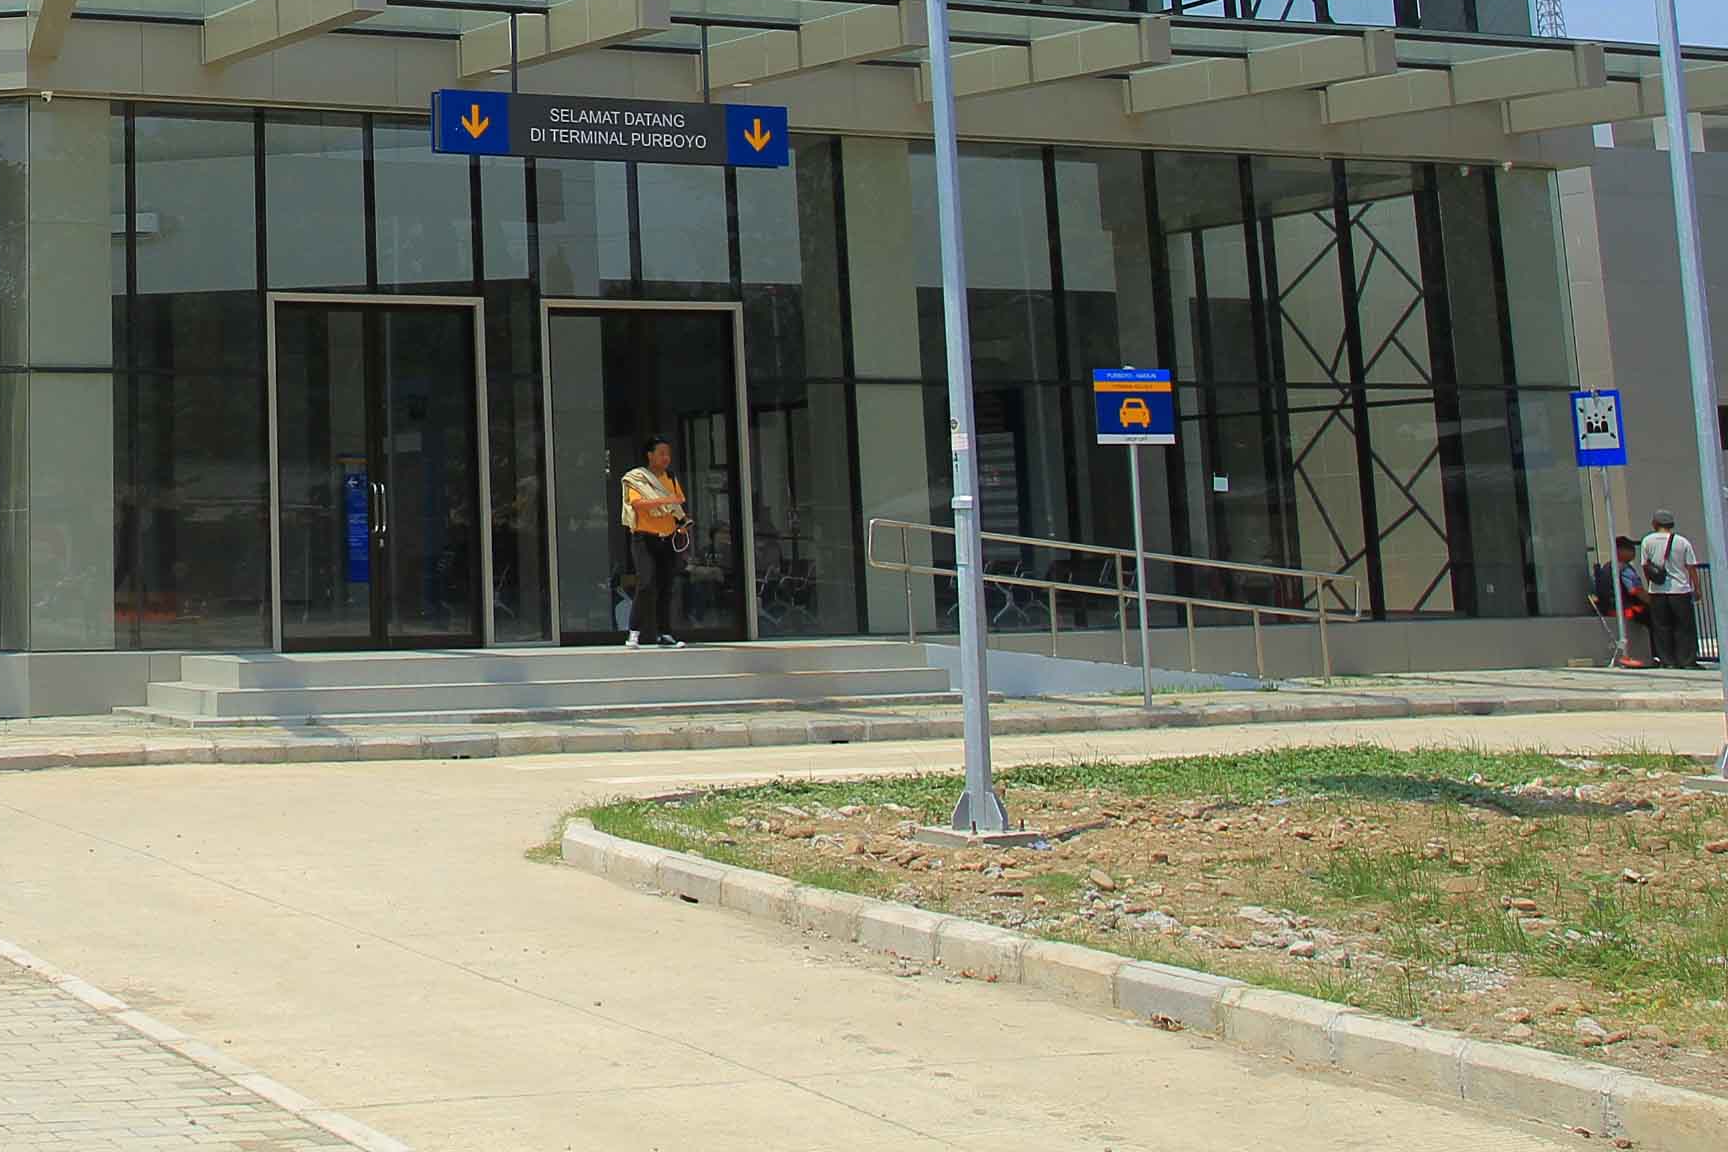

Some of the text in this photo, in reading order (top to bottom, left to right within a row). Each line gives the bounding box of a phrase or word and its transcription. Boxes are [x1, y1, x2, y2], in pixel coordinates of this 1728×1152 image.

[550, 108, 685, 128] SELAMAT DATANG
[530, 128, 707, 149] DI TERMINAL PURBOYO
